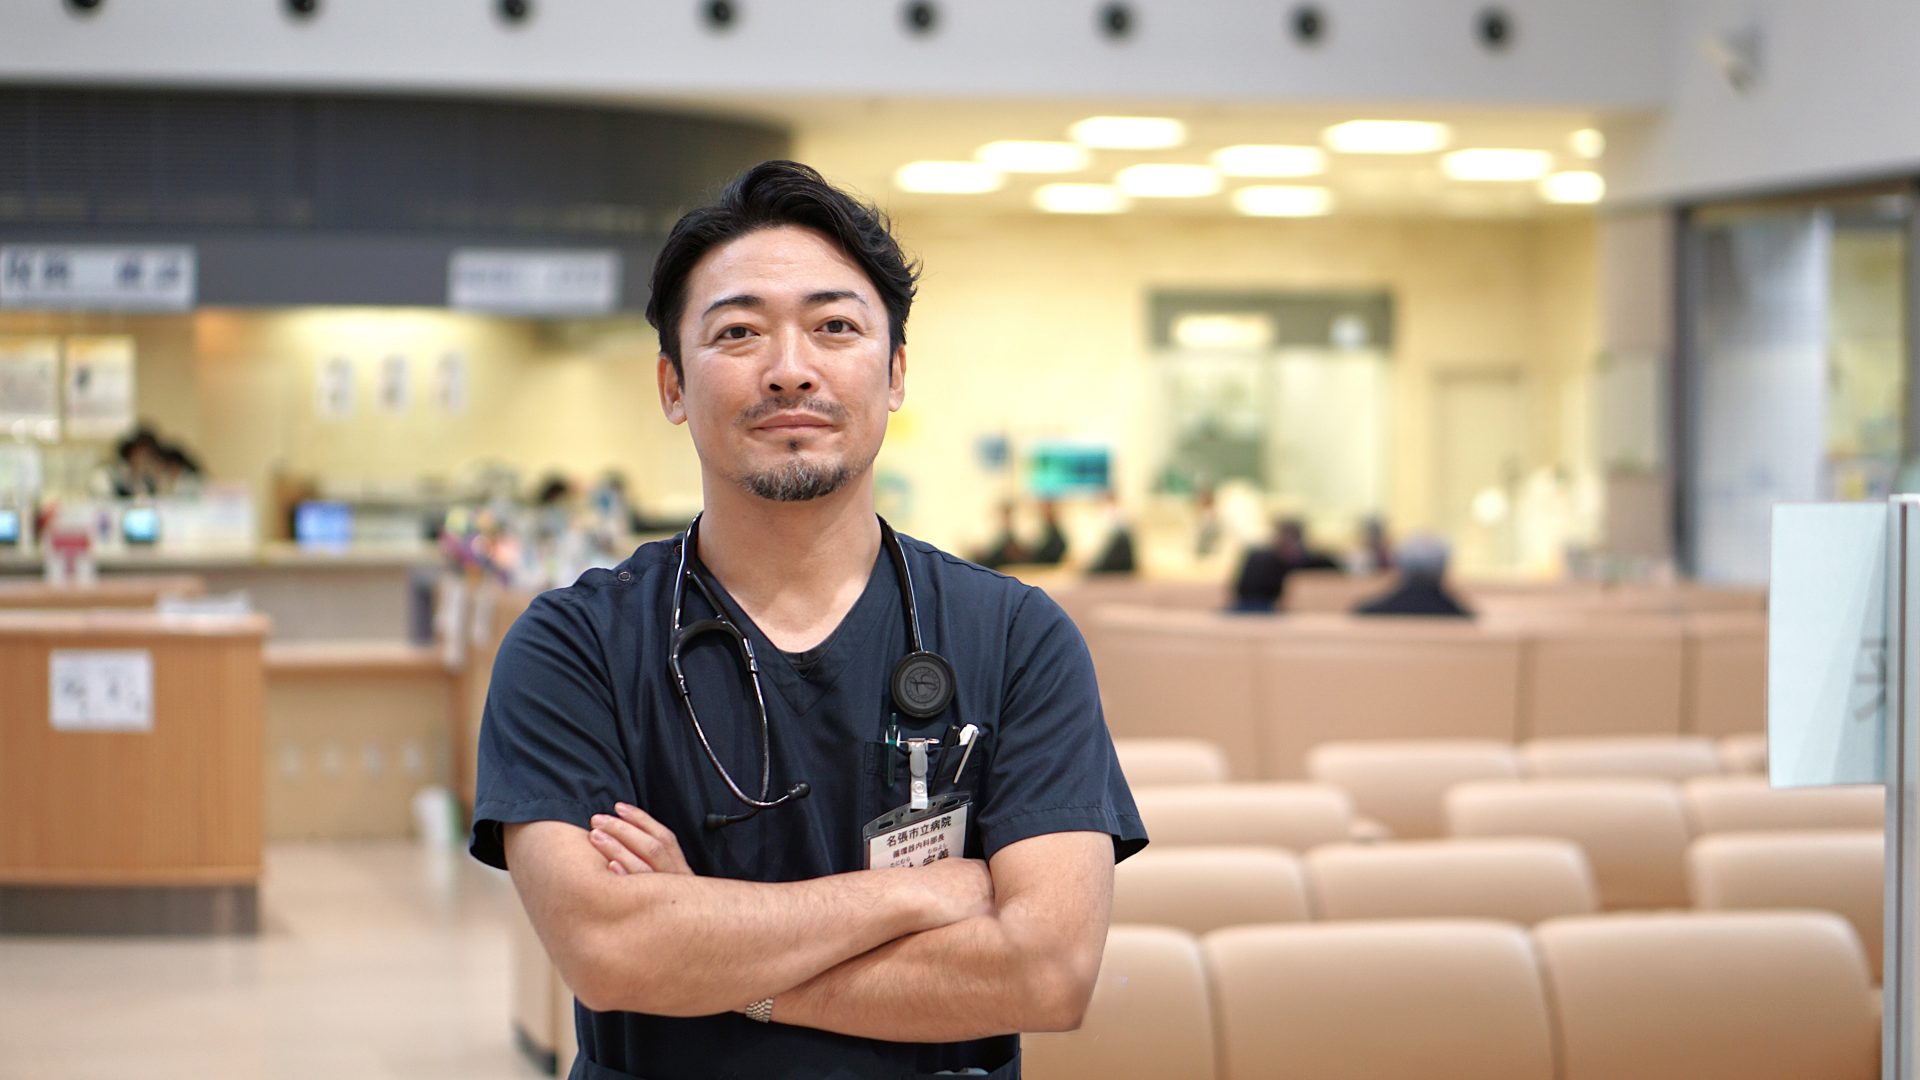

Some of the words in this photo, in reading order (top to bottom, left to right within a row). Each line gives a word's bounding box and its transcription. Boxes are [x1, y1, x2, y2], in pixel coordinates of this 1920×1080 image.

[887, 816, 952, 847] 名張市立病院
